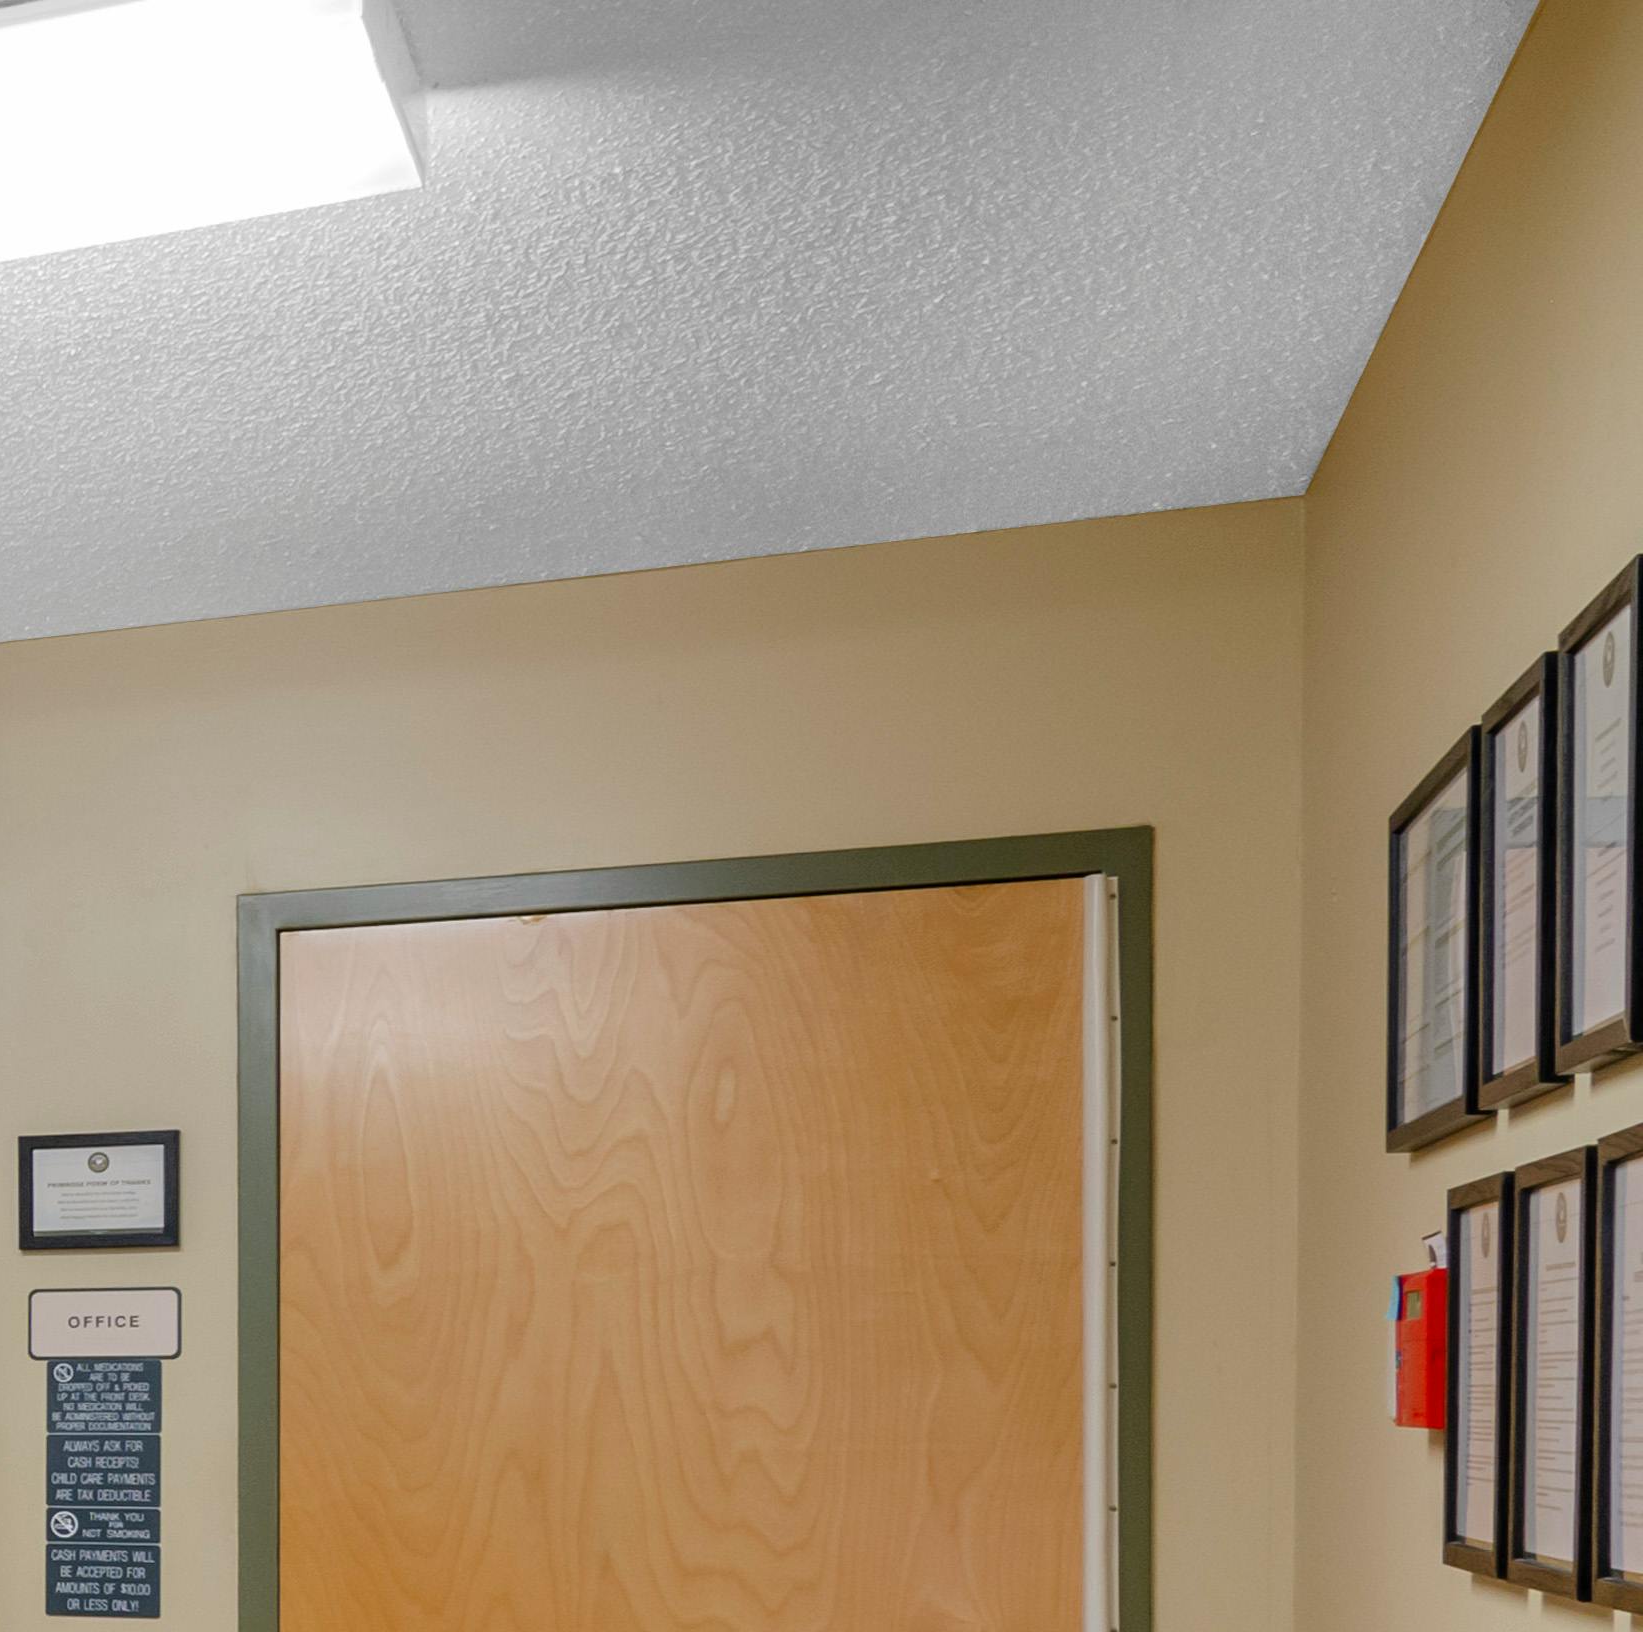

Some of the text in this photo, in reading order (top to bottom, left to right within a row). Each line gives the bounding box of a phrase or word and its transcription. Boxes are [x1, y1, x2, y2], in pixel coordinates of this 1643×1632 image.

[68, 1315, 140, 1328] OFFICE
[76, 1363, 143, 1372] ALL MEDICATIONS
[89, 1373, 130, 1382] ARE TO BE
[58, 1382, 93, 1392] DROPPED
[96, 1382, 111, 1392] OFF
[123, 1382, 149, 1392] PICKED
[57, 1392, 68, 1401] UP
[71, 1392, 79, 1401] AT
[83, 1392, 97, 1401] THE
[101, 1392, 125, 1401] FRONT
[63, 1402, 143, 1411] NO MEDICATION WILL
[51, 1412, 155, 1421] BE ADMINISTERED WITHOUT
[55, 1422, 151, 1431] PROPER DOCUMENTATION
[63, 1440, 143, 1452] ALWAYS ASK FOR
[67, 1456, 139, 1468] CASH RECEIPTS!
[51, 1472, 156, 1486] CHILD CARE PAYMENTS
[55, 1489, 151, 1502] ARE TAX DEDUCTIBLE
[89, 1512, 145, 1522] THANK YOU
[82, 1529, 151, 1538] NOT SMOKING
[51, 1550, 155, 1562] CASH PAYMENTS WILL
[60, 1566, 145, 1578] BE ACCEPTED FOR
[55, 1582, 151, 1595] AMOUNTS OF $10.00
[67, 1598, 139, 1612] OR LESS ONLY!
